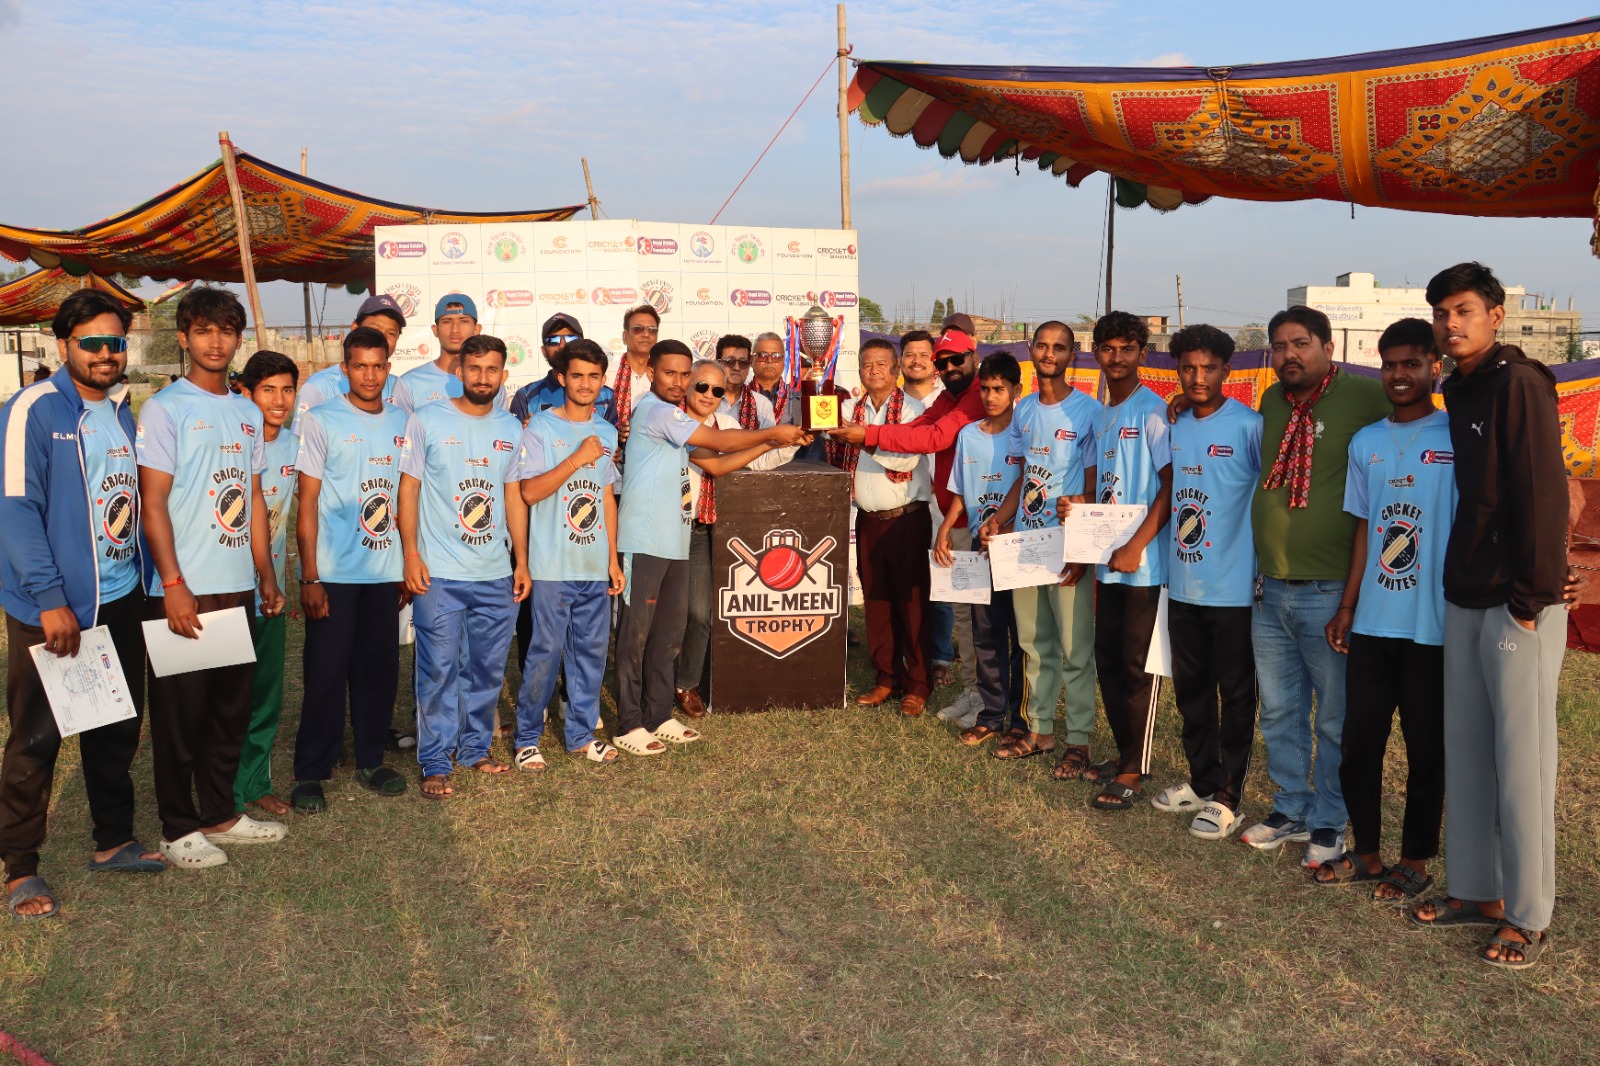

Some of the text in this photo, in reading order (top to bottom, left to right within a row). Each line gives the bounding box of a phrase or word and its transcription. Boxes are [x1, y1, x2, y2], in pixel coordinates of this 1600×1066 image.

[539, 293, 575, 301] CRICKET
[775, 294, 806, 302] CRICKET
[102, 472, 136, 492] CRICKET
[360, 477, 394, 493] CRICKET
[567, 479, 602, 494] CRICKET
[1175, 487, 1209, 505] CRICKET
[1021, 515, 1045, 530] UNITES
[218, 532, 249, 549] UNITES
[361, 535, 393, 551] UNITES
[460, 532, 493, 546] UNITES
[568, 531, 597, 546] UNITES
[105, 542, 135, 561] UNITES
[1176, 547, 1204, 564] UNITES
[1377, 571, 1418, 592] UNITES
[726, 592, 834, 613] ANIL-MEEN
[745, 619, 815, 634] TROPHY
[1498, 637, 1517, 652] alo
[521, 748, 537, 758] NIKE
